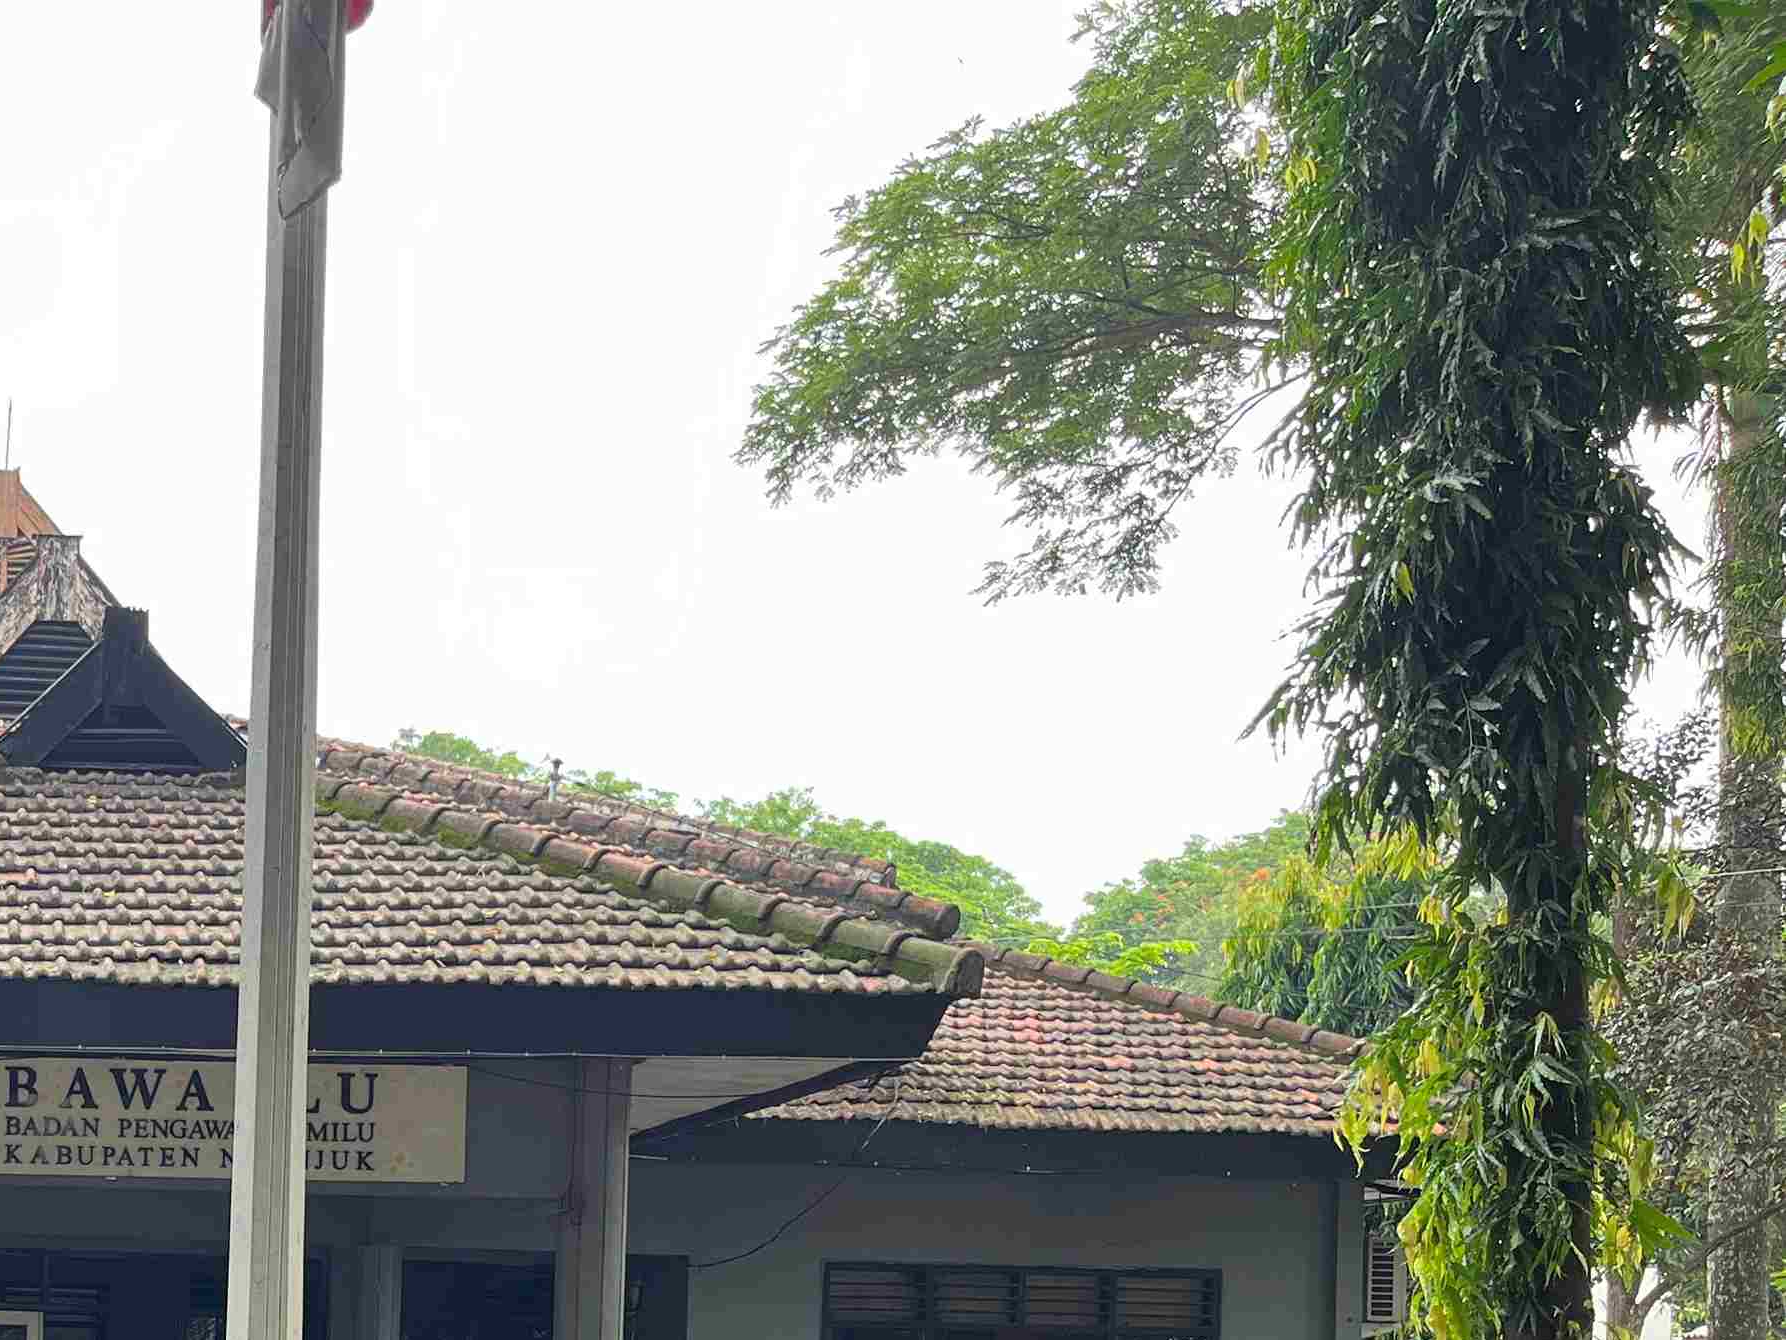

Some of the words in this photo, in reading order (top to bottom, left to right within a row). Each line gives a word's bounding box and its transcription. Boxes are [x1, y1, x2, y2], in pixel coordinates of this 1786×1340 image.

[4, 1066, 379, 1114] BAWAU
[5, 1116, 100, 1137] BADAN
[117, 1119, 236, 1139] PENGAWA
[306, 1122, 376, 1142] MILU
[5, 1144, 199, 1168] KABUPATEN
[220, 1148, 375, 1171] NJUK
